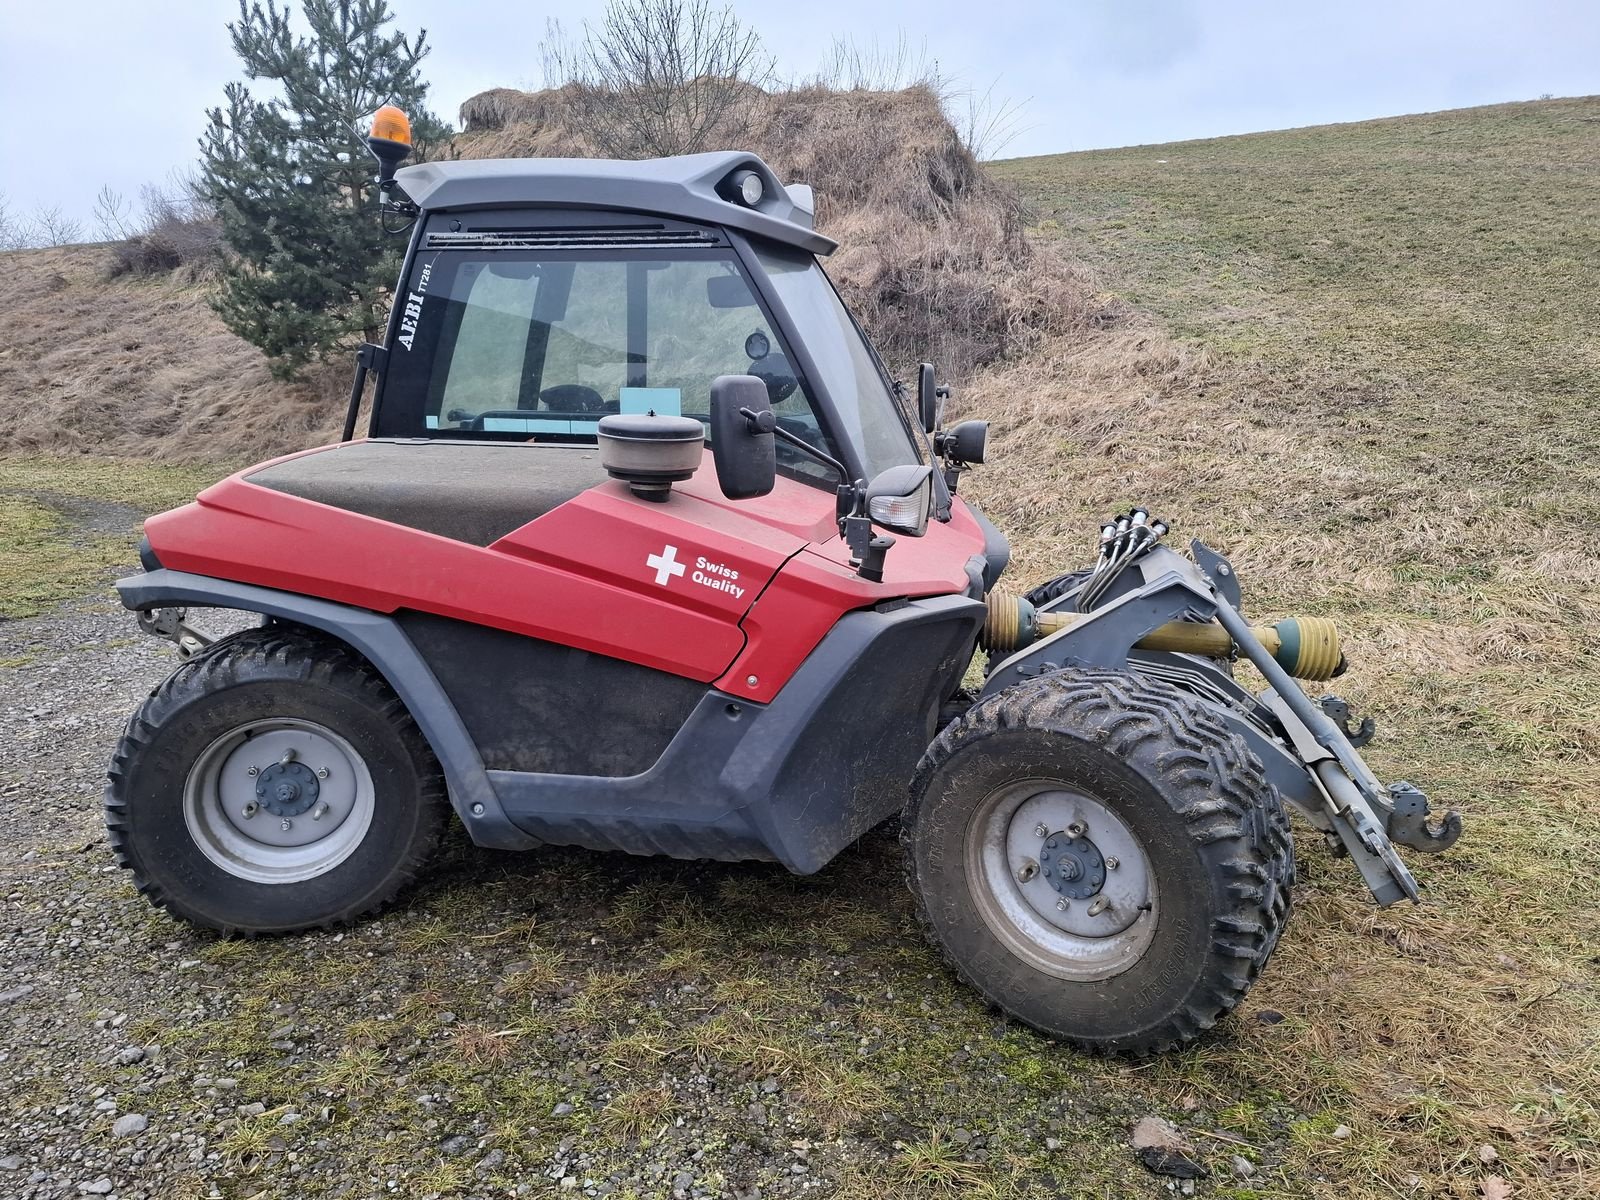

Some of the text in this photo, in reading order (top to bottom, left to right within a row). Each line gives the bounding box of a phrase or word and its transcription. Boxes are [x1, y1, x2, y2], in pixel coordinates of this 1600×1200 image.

[398, 263, 432, 352] AEBI TT281
[695, 556, 739, 580] Swiss
[691, 570, 745, 599] Quality
